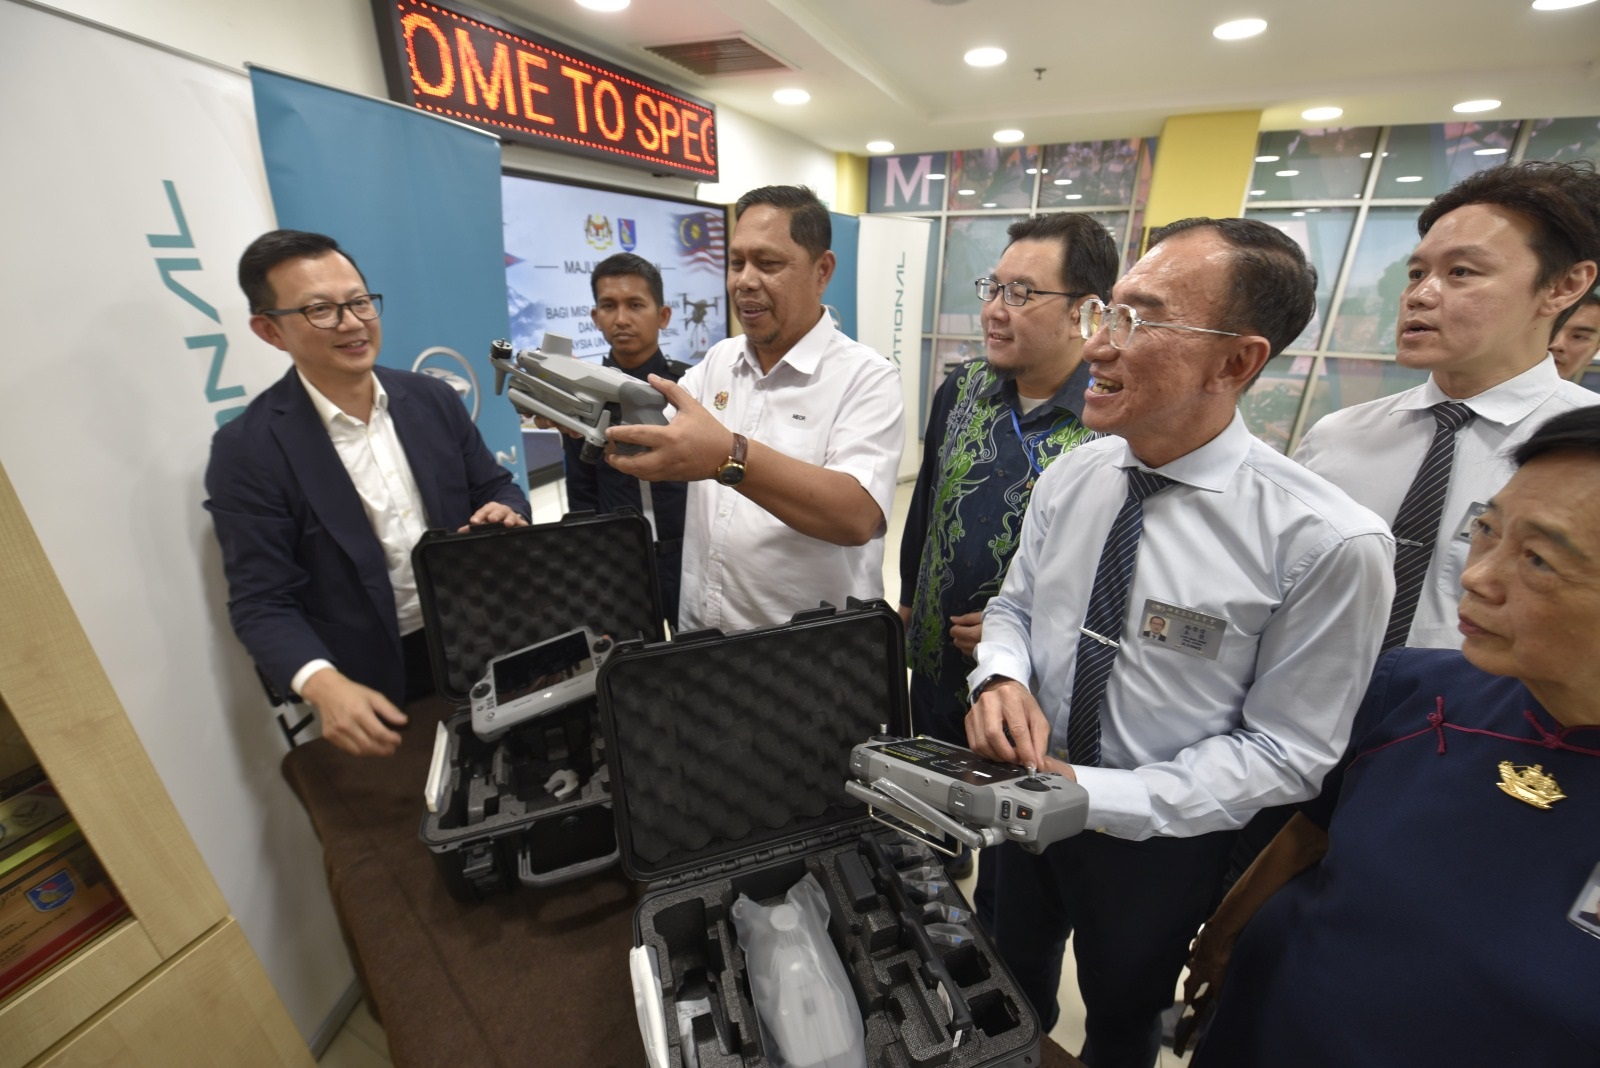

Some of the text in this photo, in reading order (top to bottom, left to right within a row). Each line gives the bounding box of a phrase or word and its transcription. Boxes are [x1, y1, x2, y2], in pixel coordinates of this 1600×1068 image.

[401, 12, 554, 125] OME
[561, 65, 625, 142] TO
[884, 155, 933, 207] M
[564, 260, 599, 275] MAJLI
[546, 305, 590, 320] BAGI MISI
[891, 252, 906, 373] ATIONAL
